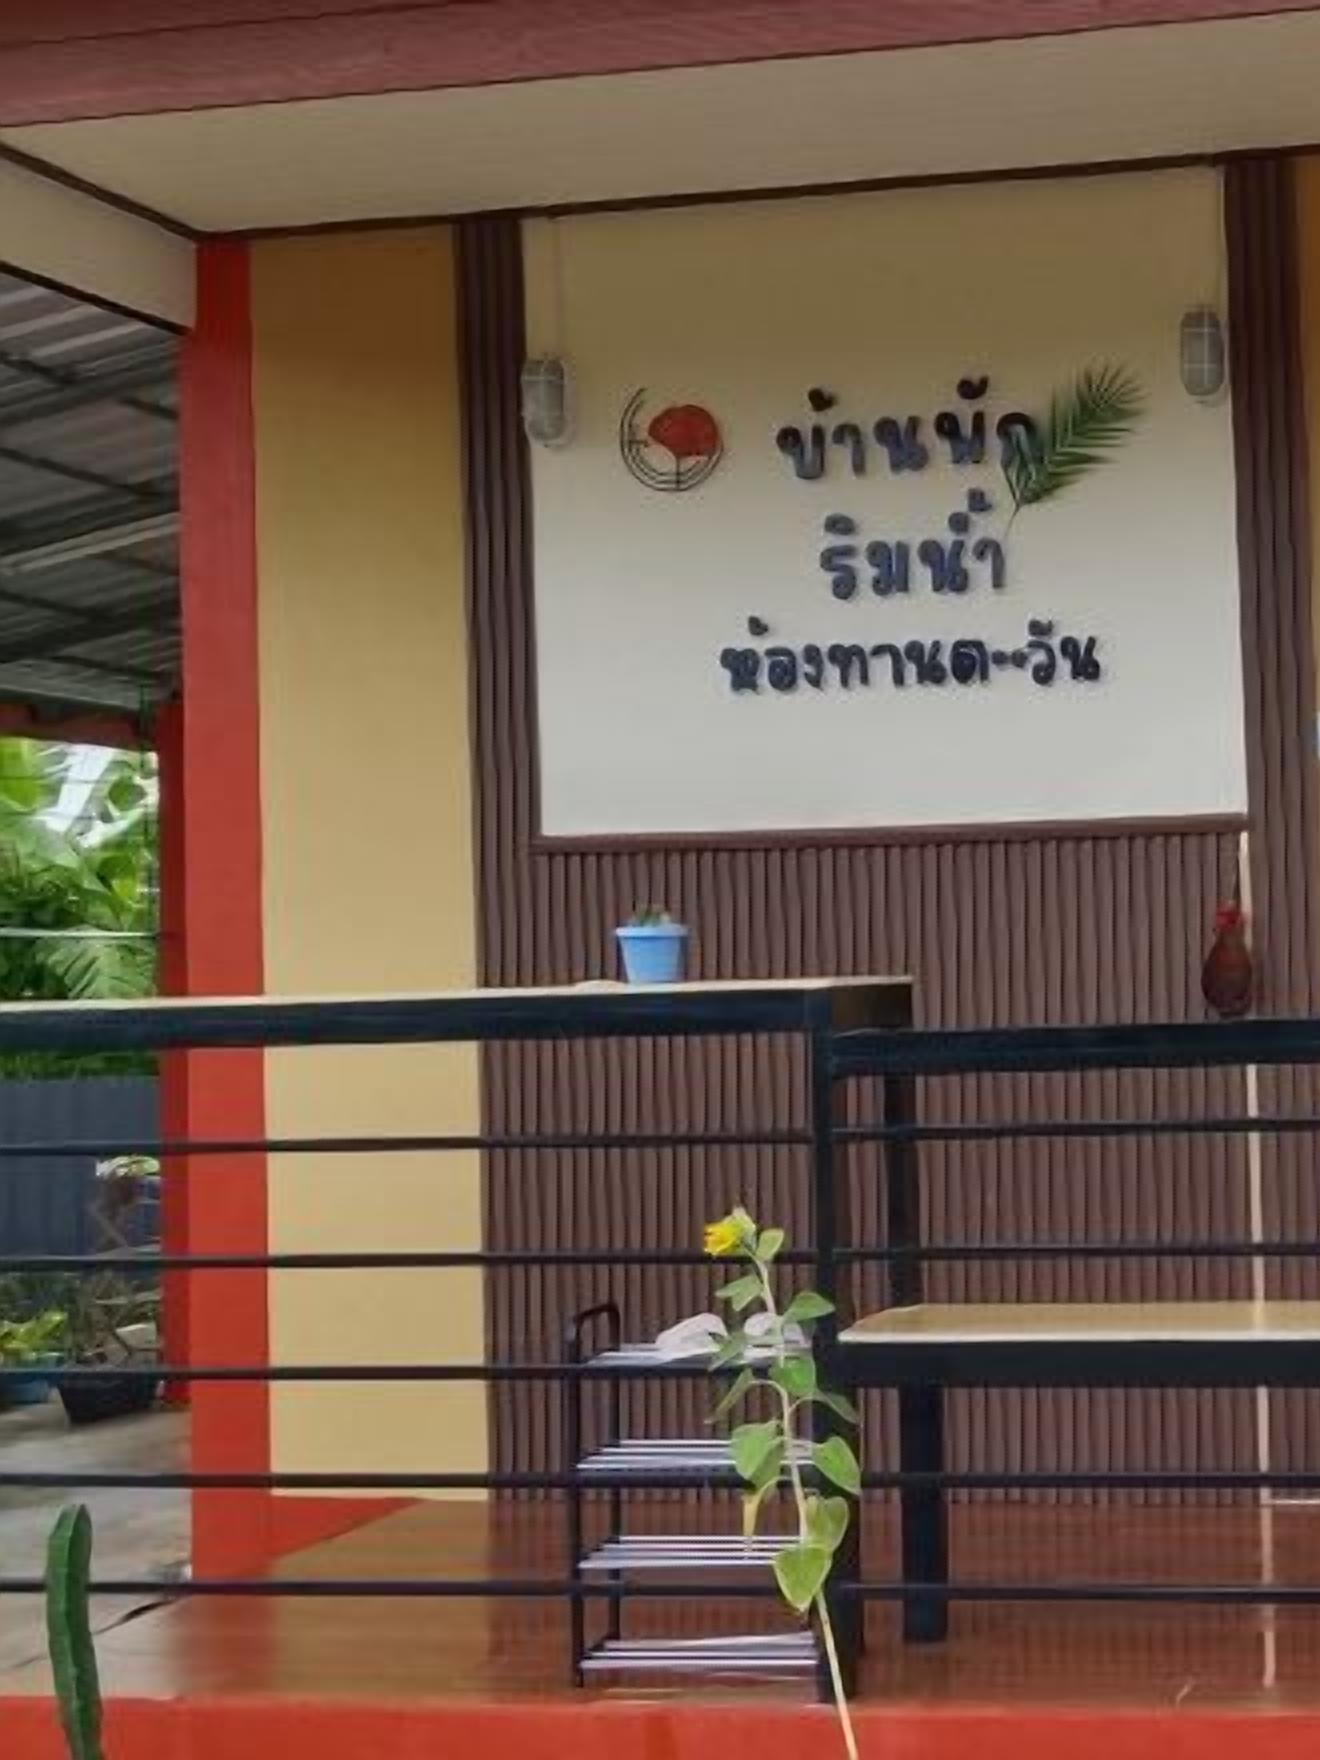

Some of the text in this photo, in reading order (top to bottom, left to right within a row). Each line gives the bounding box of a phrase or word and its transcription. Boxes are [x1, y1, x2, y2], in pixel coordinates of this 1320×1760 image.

[819, 487, 1006, 600] ริมน้ำ
[720, 615, 1101, 693] ห้องทานตะวัน
